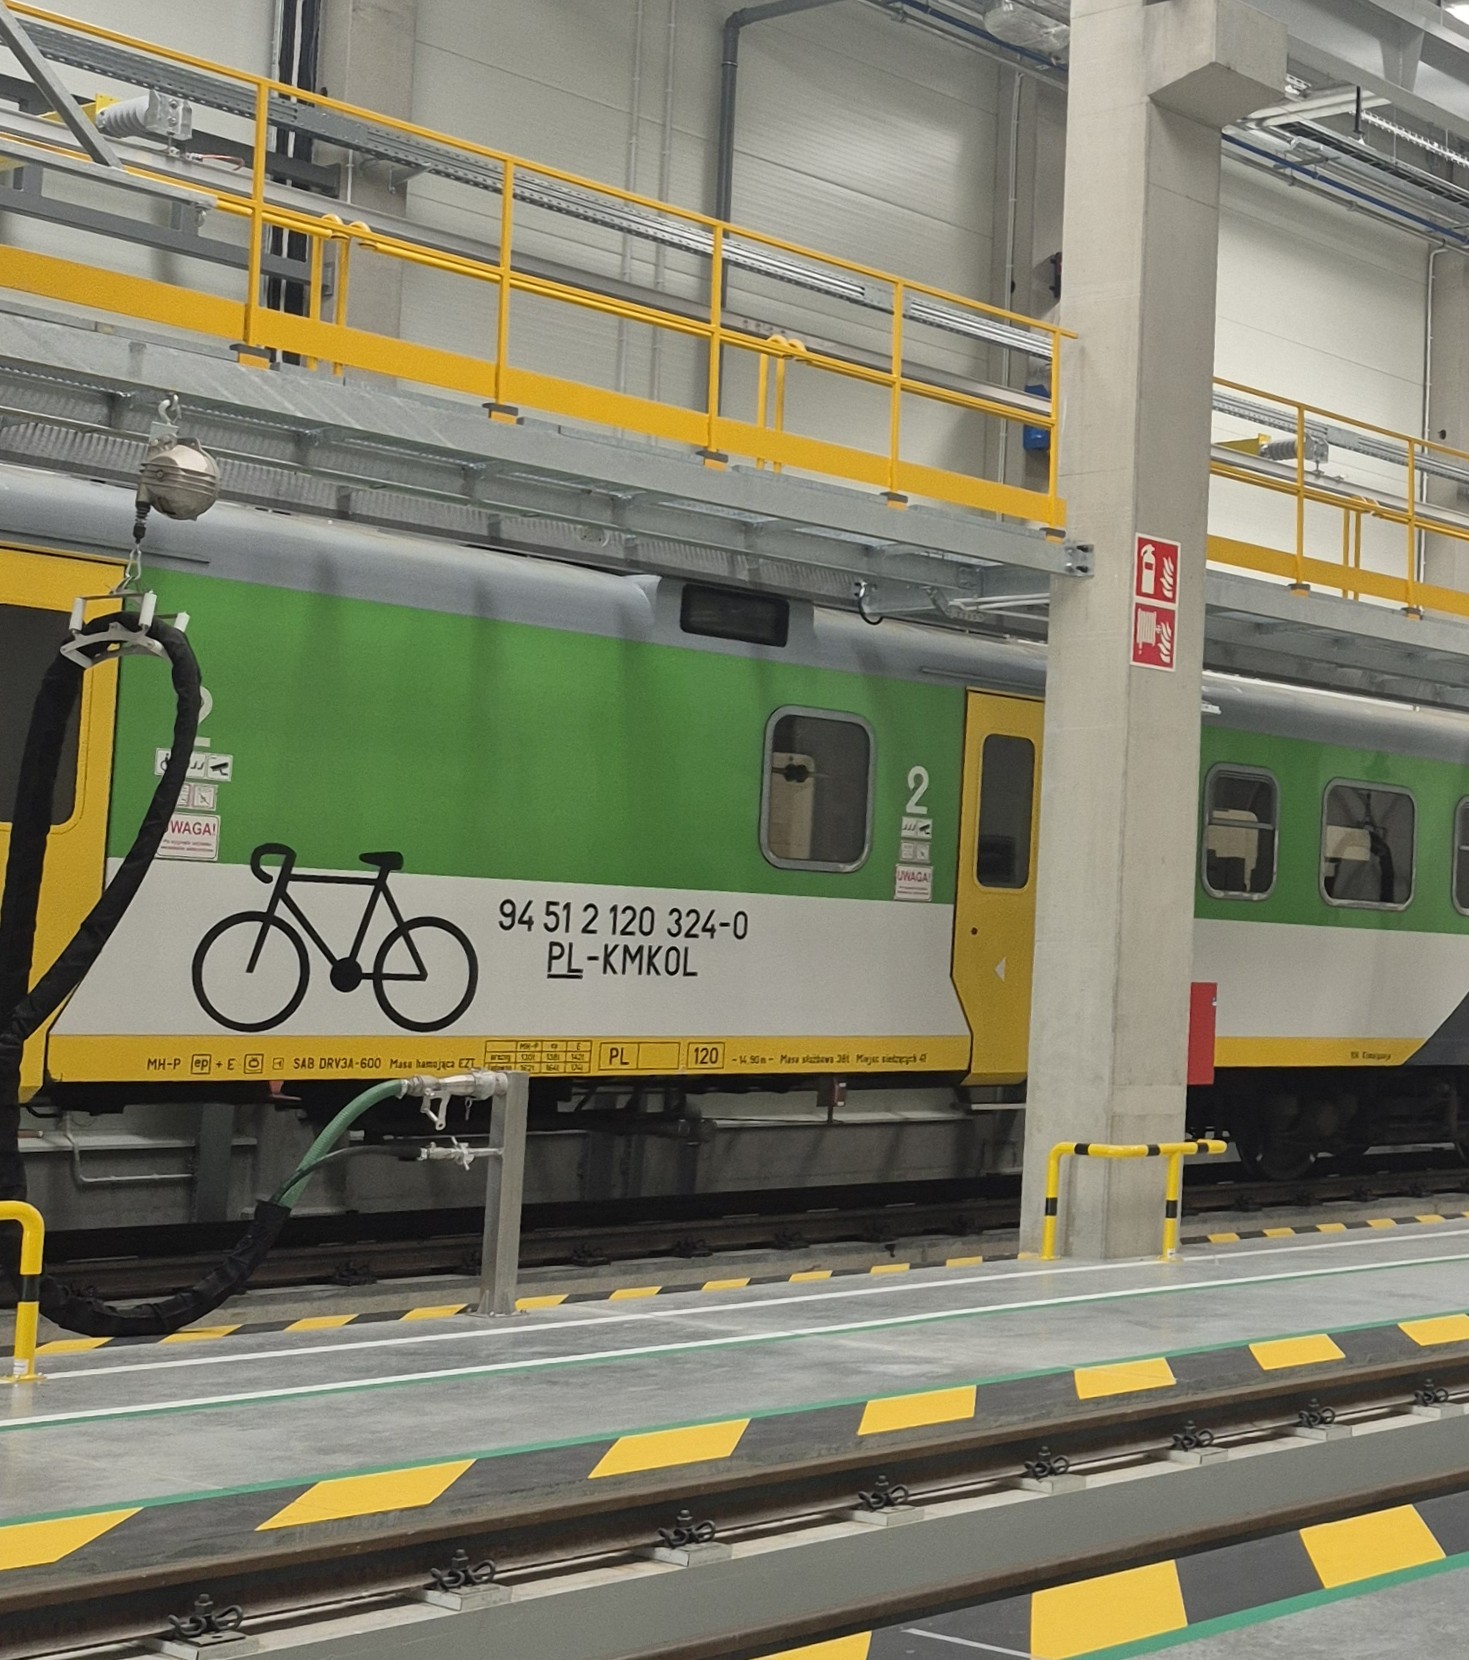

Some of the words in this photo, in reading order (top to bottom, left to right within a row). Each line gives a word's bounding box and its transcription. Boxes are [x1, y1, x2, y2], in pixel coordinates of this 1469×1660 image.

[906, 765, 929, 814] 2
[168, 819, 216, 837] WAGA!
[897, 870, 931, 882] UWAGA!
[498, 899, 534, 932] 94
[543, 901, 571, 933] 51
[581, 903, 599, 934] 2
[609, 904, 655, 937] 120
[666, 907, 748, 940] 324-0
[547, 941, 698, 978] PL-KMKOL
[147, 1057, 181, 1071] MH-P
[194, 1058, 209, 1071] ep
[227, 1058, 236, 1070] E
[293, 1057, 315, 1070] SAB
[319, 1057, 382, 1070] DRV3A-600
[609, 1047, 630, 1065] PL
[694, 1047, 719, 1065] 120
